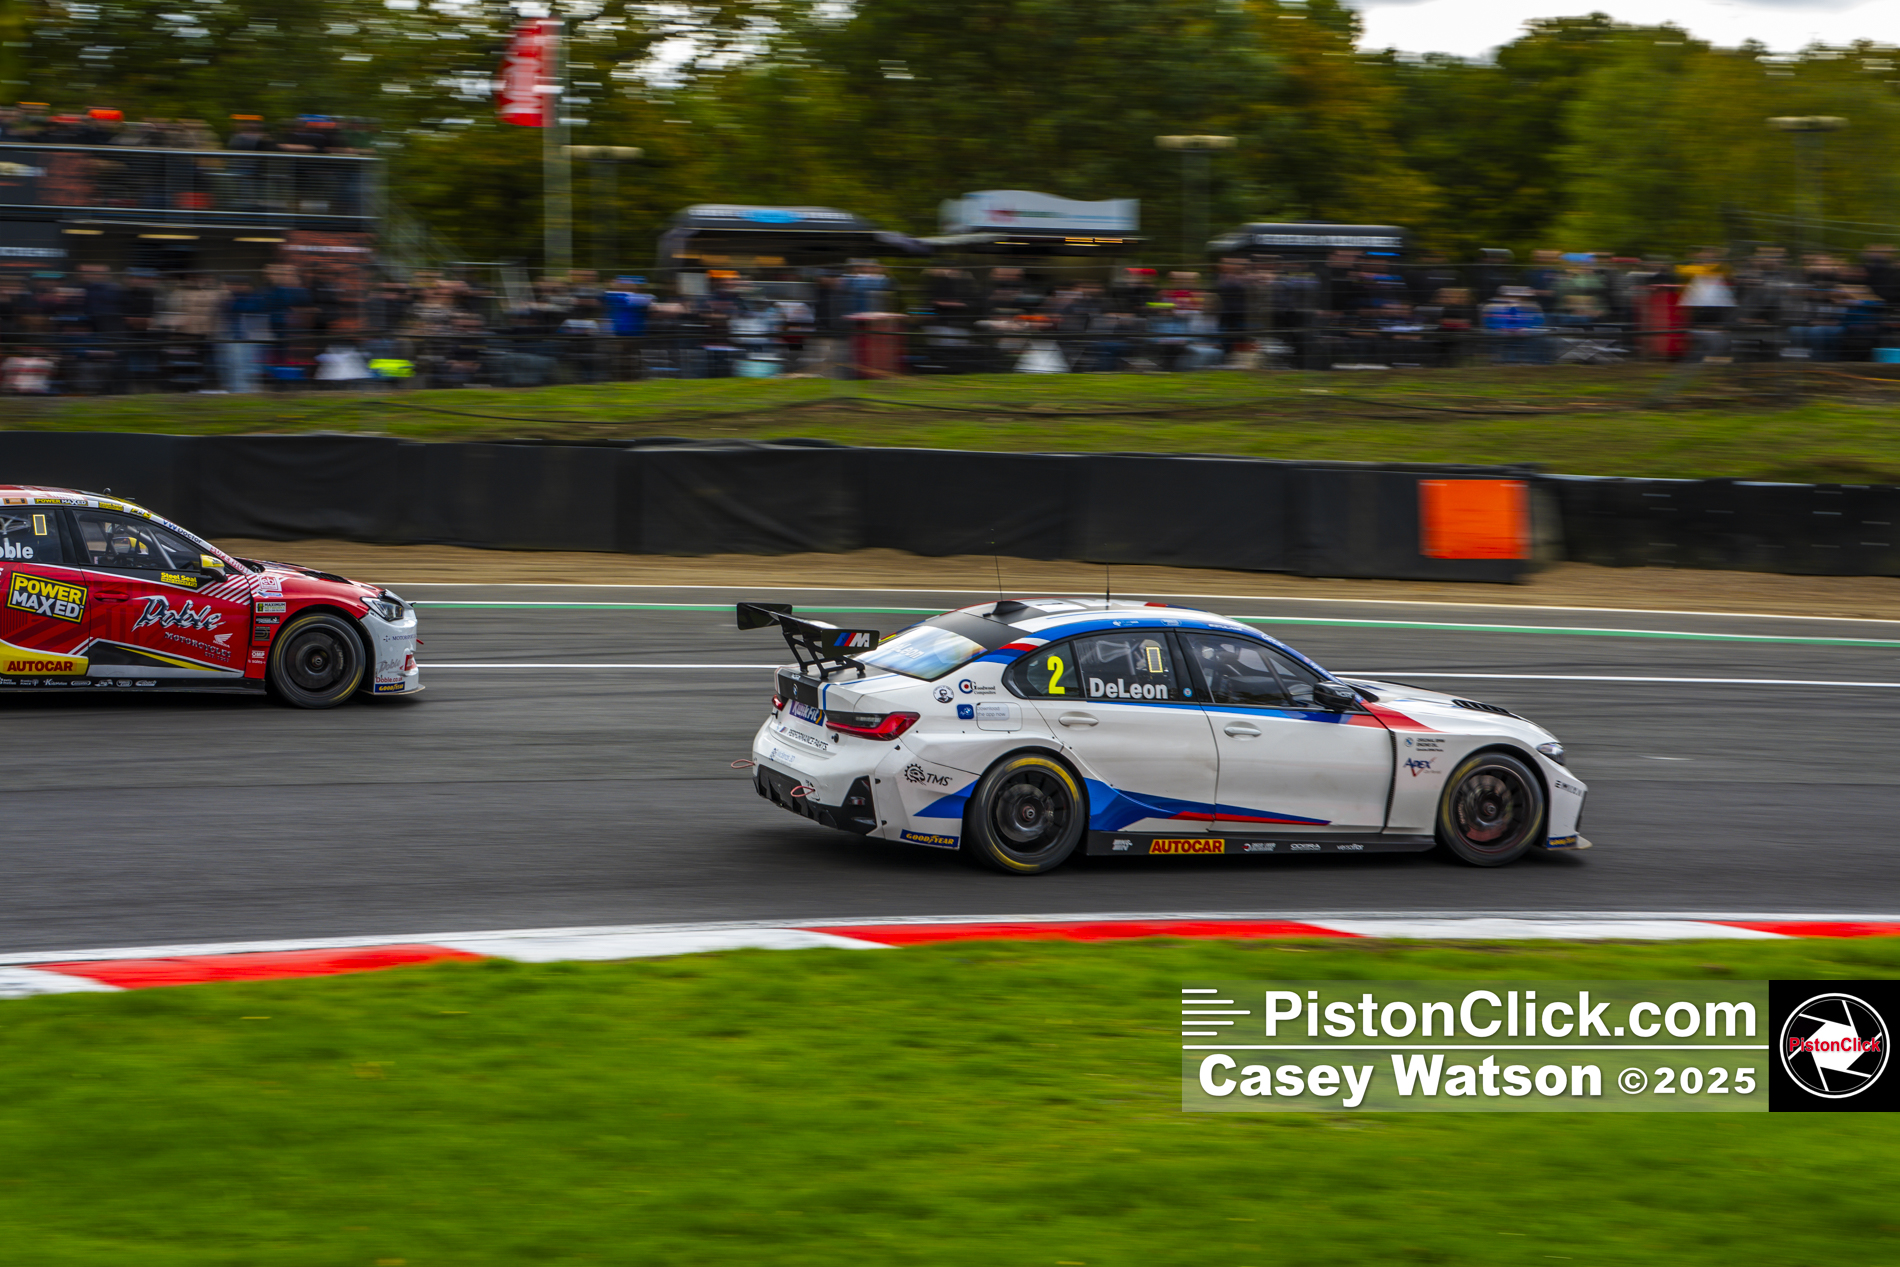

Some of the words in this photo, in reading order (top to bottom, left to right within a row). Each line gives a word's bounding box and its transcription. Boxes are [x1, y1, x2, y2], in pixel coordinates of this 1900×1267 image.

[163, 520, 177, 530] VW
[177, 528, 202, 544] Doctor
[161, 572, 180, 580] Steel
[181, 575, 197, 583] Seal
[14, 576, 82, 604] POWER
[11, 590, 80, 618] MAXED
[131, 595, 226, 631] Doble
[164, 631, 232, 658] MOTORCYCLES
[849, 632, 870, 648] M
[7, 661, 73, 672] AUTOCAR
[1047, 655, 1065, 694] 2
[970, 681, 996, 690] Goodwood
[1089, 677, 1168, 699] DeLeon
[927, 773, 949, 786] TMS
[905, 833, 955, 845] GOODYEAR
[1151, 839, 1223, 853] AUTOCAR
